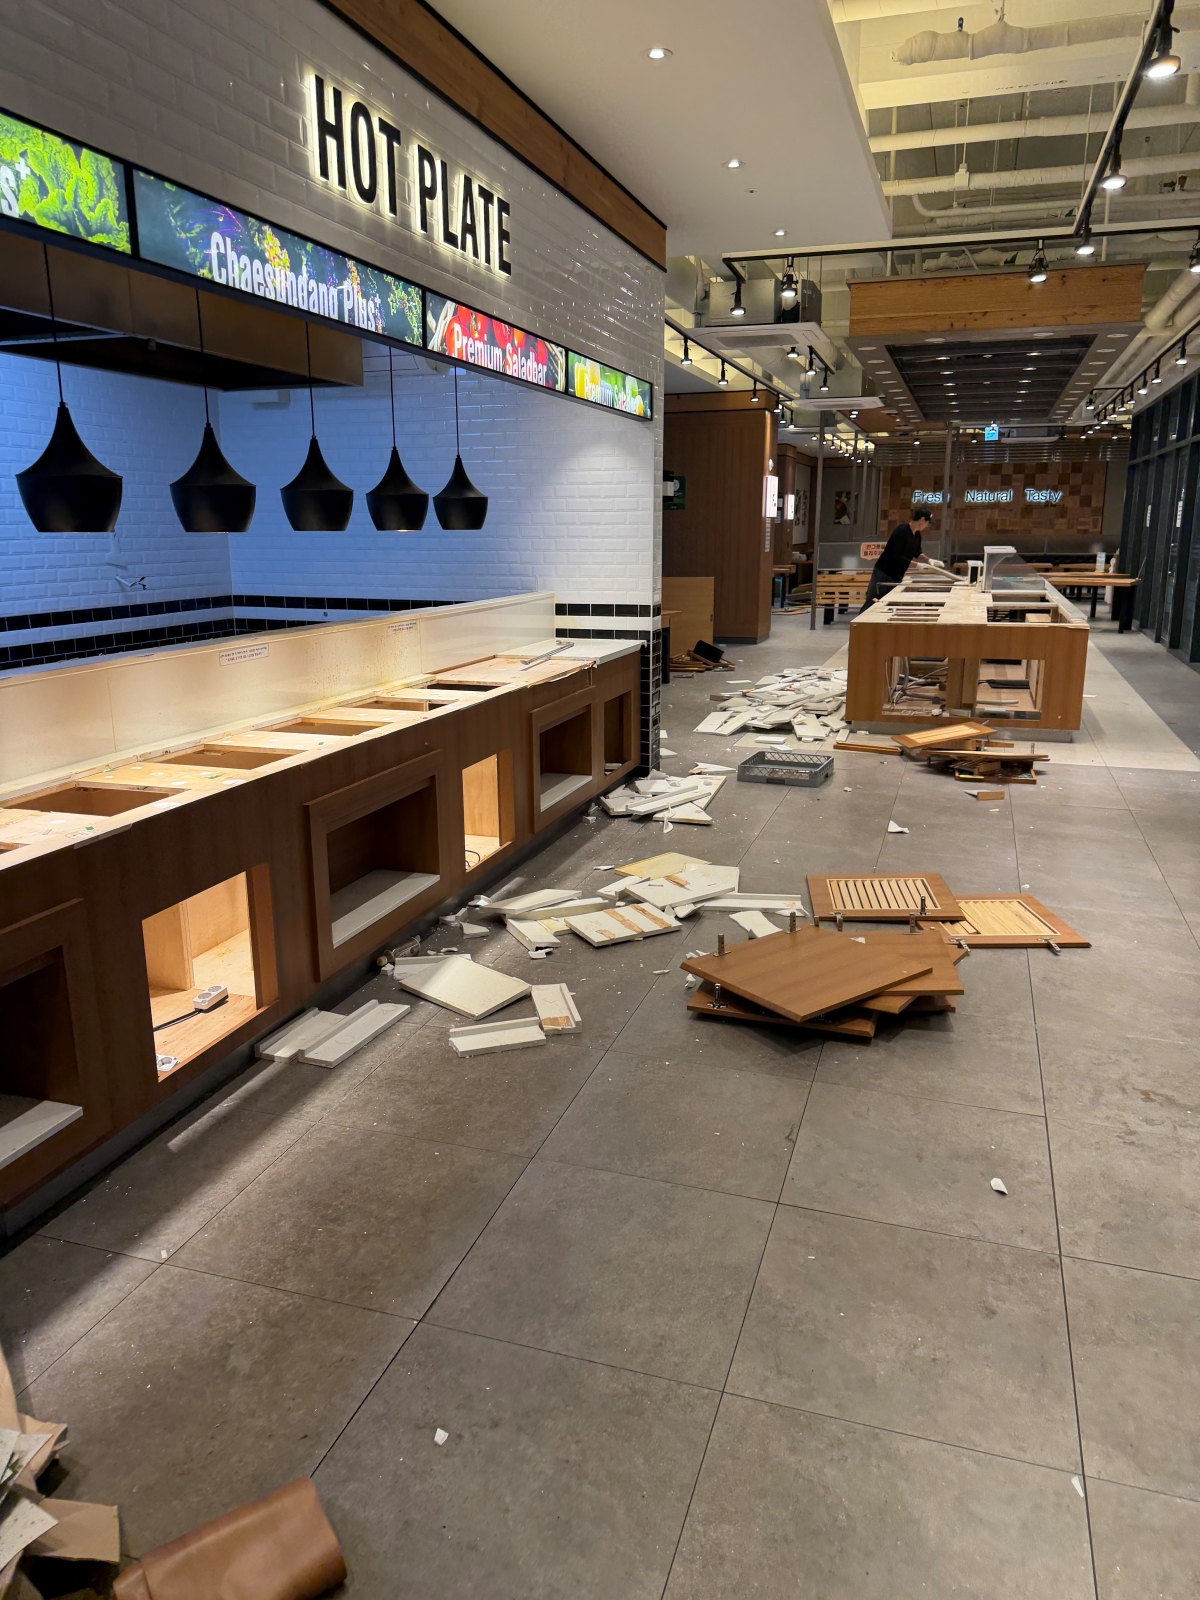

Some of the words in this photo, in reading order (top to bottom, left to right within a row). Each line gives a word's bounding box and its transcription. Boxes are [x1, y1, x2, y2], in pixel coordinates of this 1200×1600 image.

[312, 73, 401, 217] HOT
[416, 143, 512, 276] PLATE
[210, 231, 339, 320] Chaesundang
[453, 322, 503, 373] Premium
[505, 342, 548, 386] Saladbar
[964, 489, 1013, 502] Natural
[1024, 488, 1062, 503] Tasty
